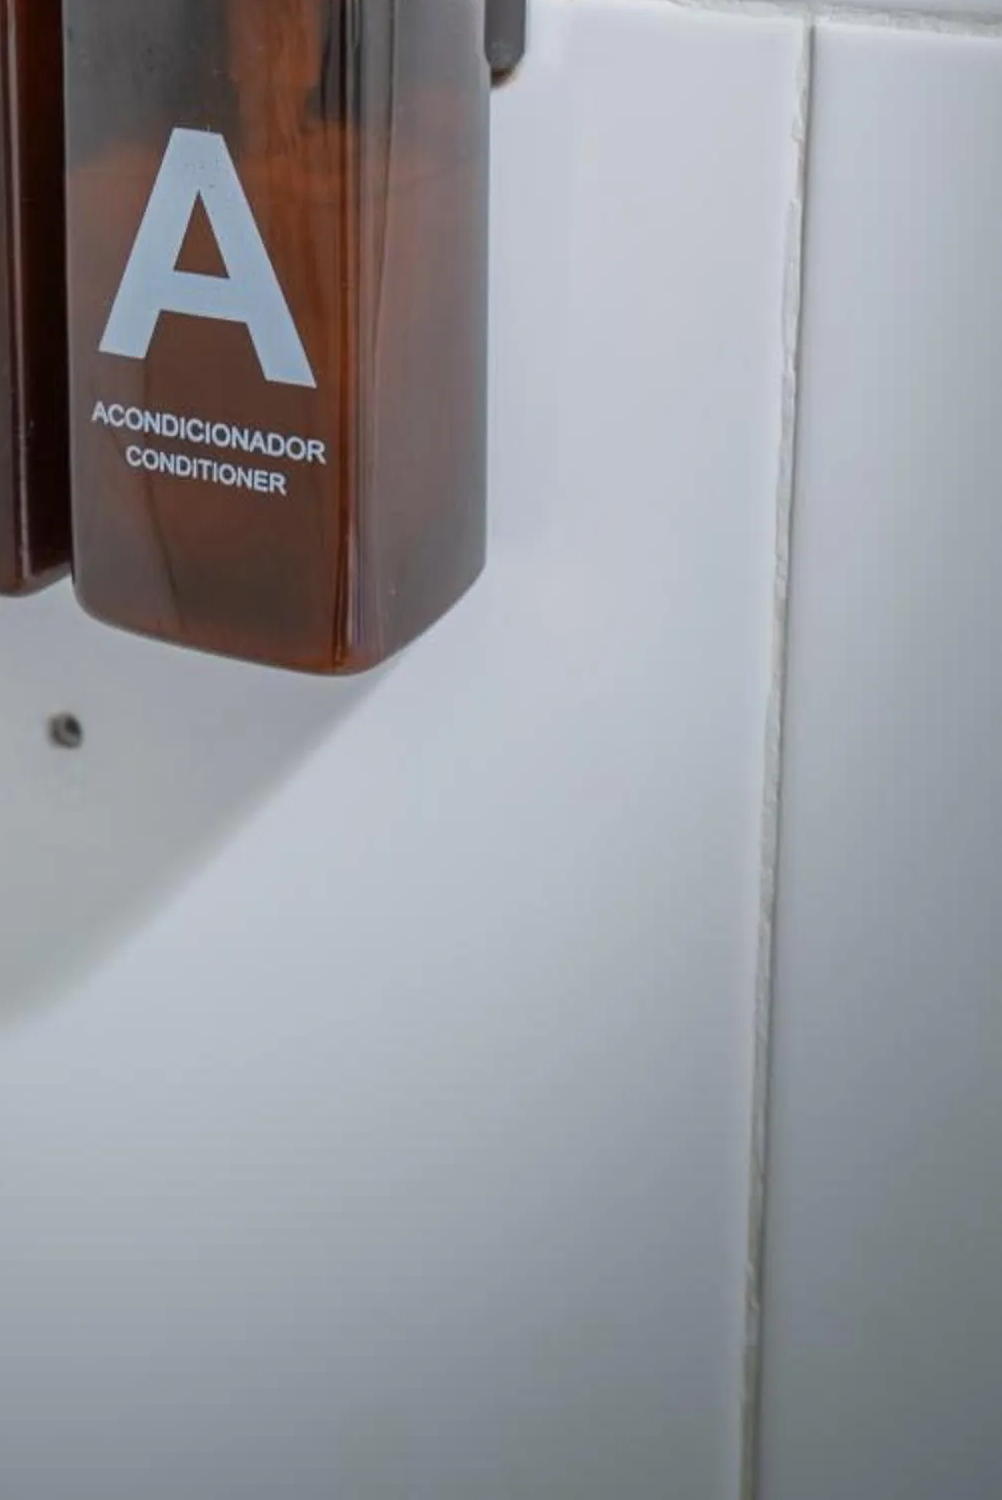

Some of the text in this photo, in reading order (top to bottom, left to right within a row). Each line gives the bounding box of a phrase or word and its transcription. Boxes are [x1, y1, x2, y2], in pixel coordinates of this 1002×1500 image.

[98, 127, 317, 389] A
[91, 401, 326, 465] ACONDICIONADOR
[125, 445, 288, 496] CONDITIONER
